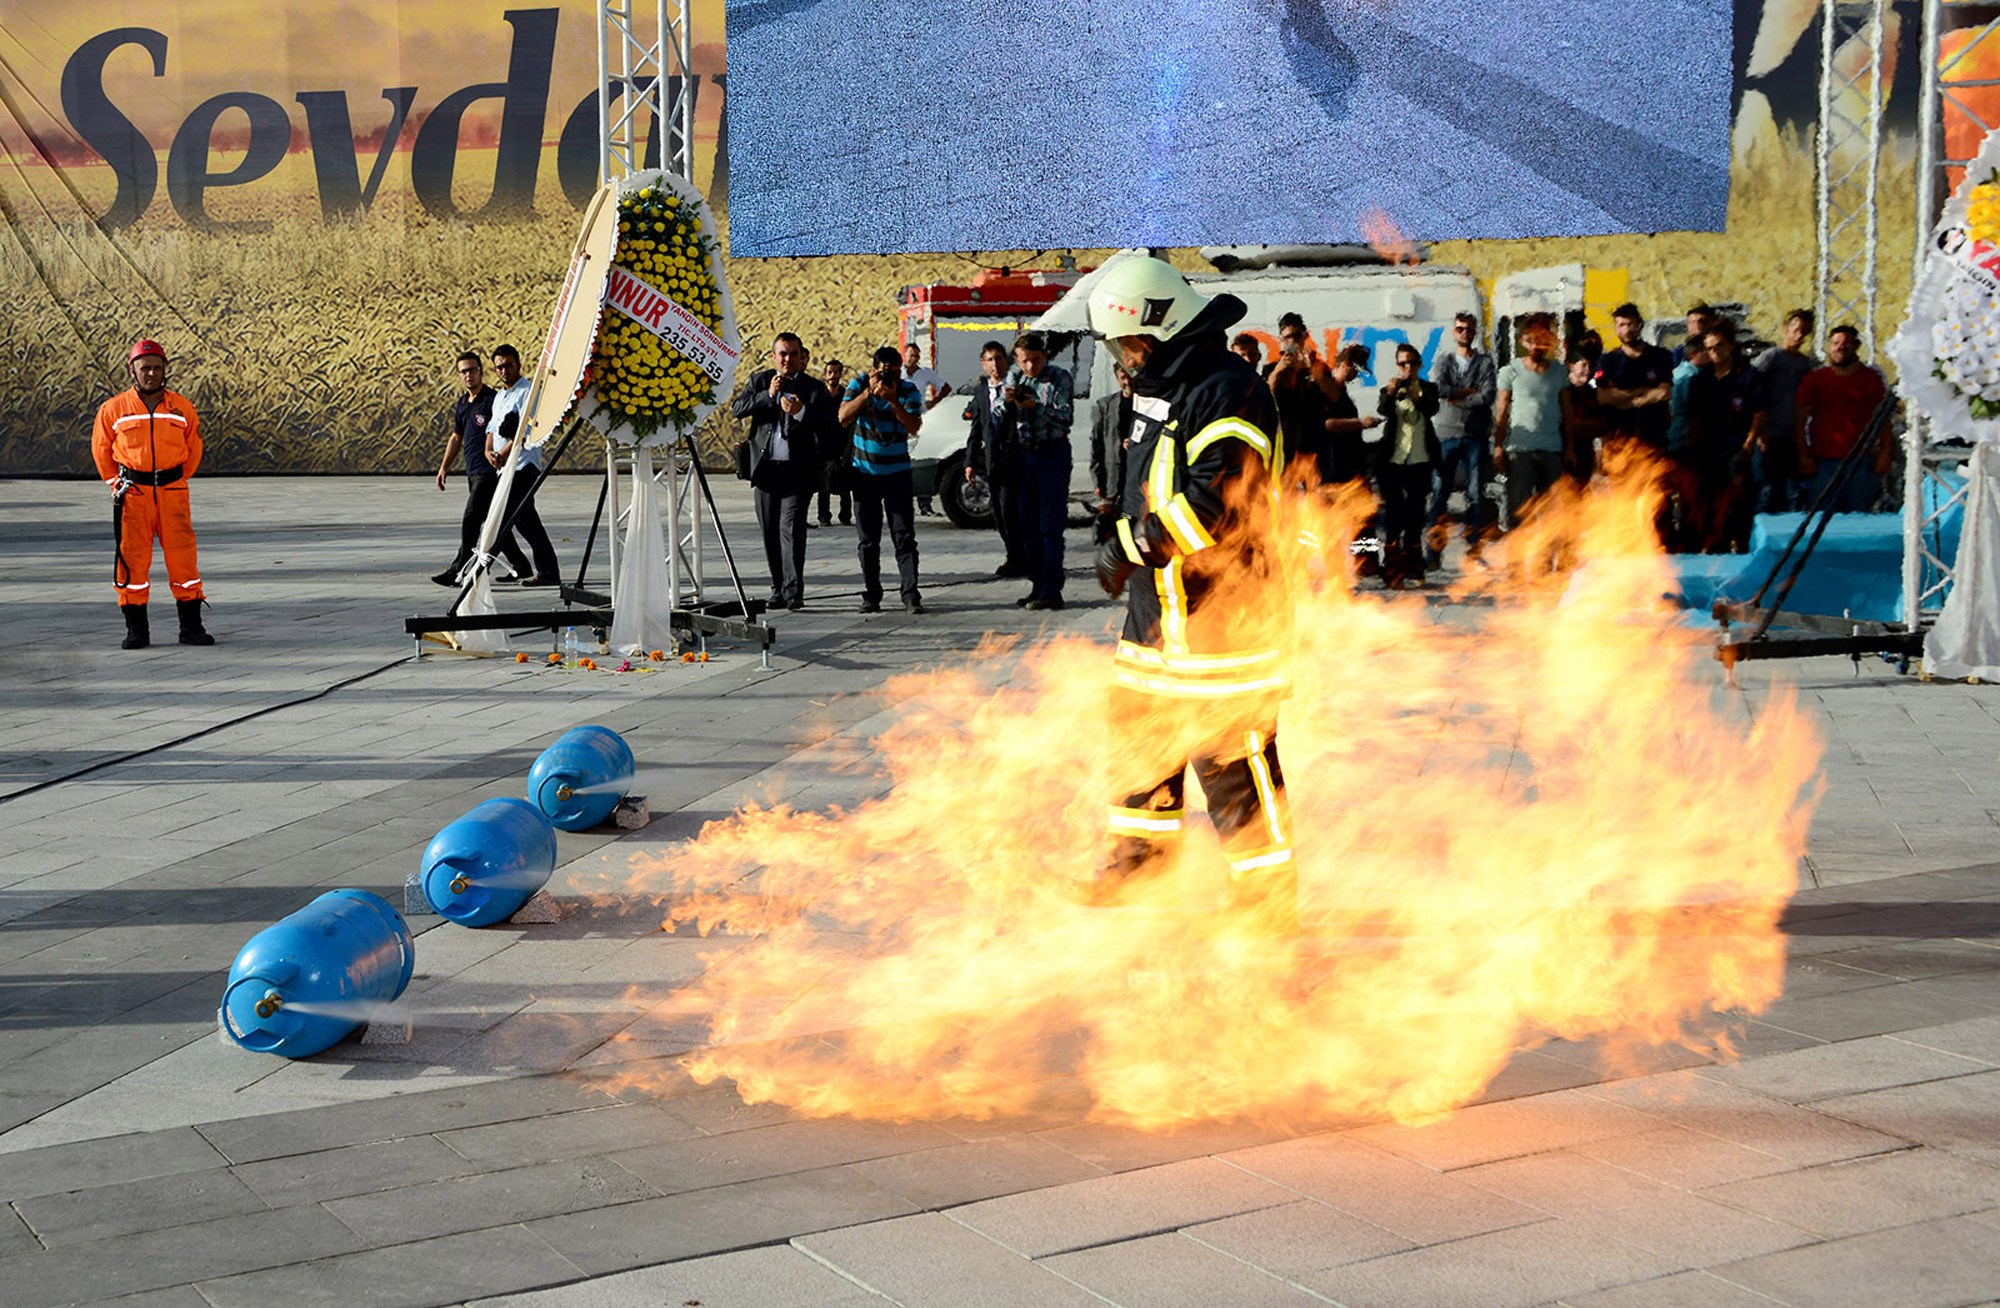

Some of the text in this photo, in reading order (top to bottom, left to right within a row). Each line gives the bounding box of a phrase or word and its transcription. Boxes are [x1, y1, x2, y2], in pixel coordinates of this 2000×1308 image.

[660, 326, 724, 380] 235 53 55
